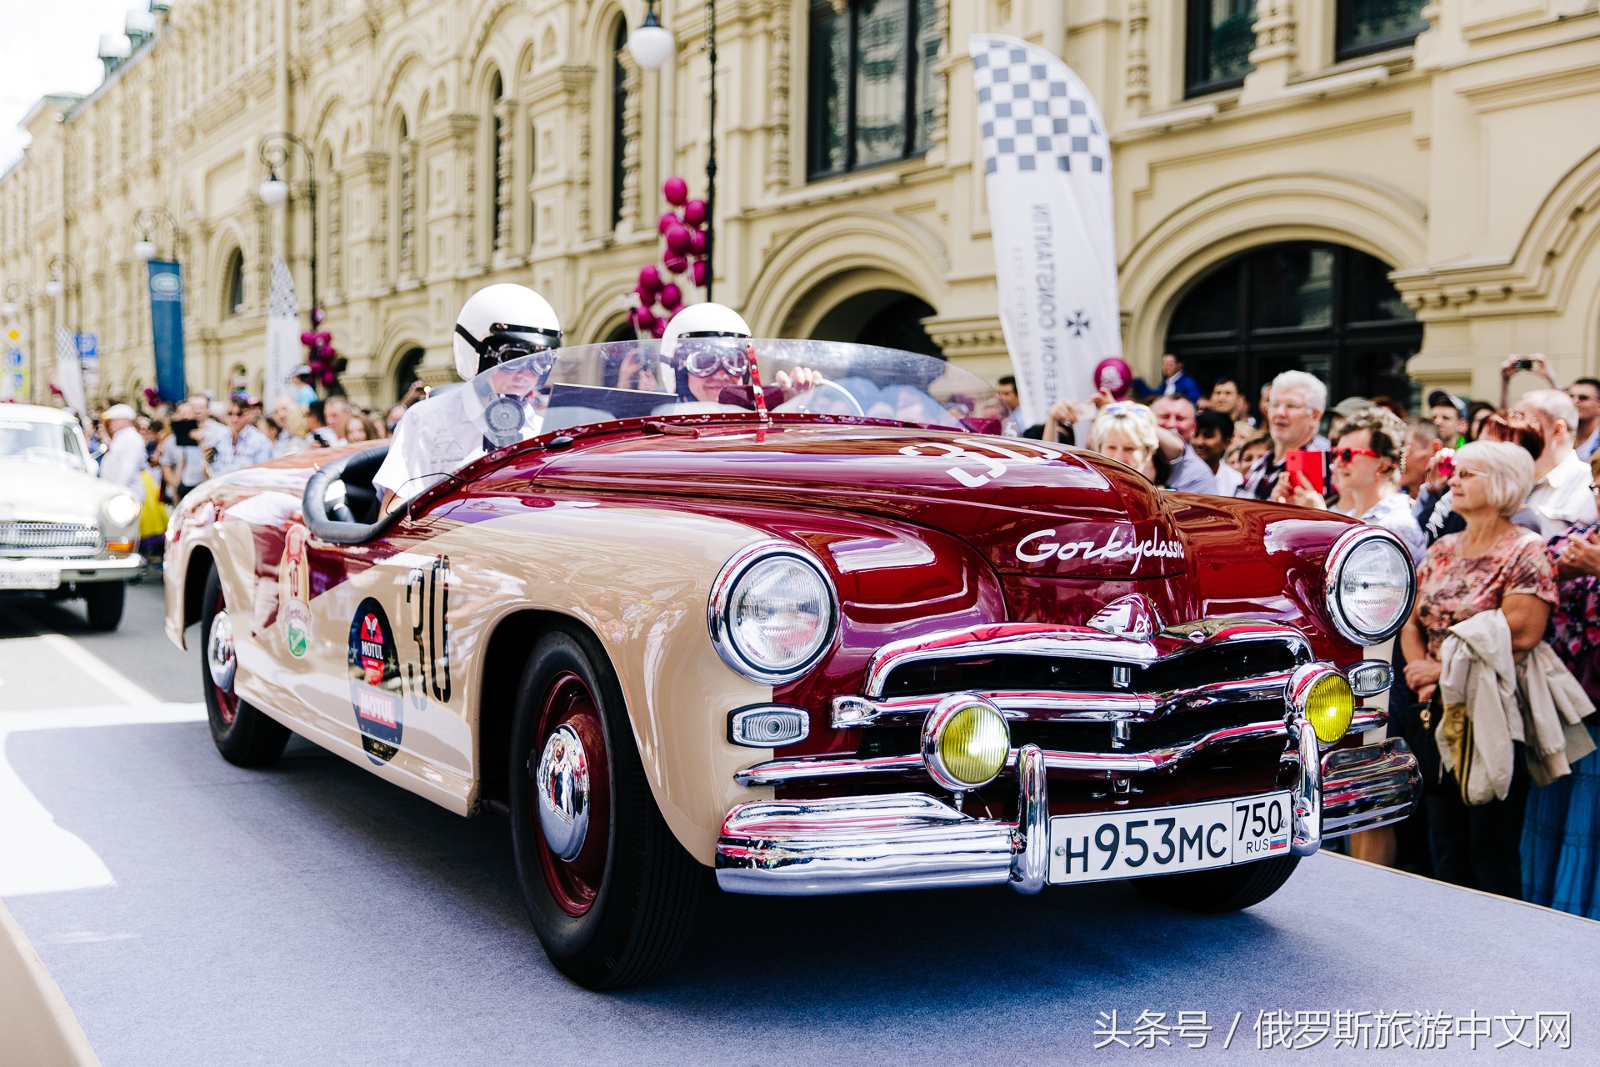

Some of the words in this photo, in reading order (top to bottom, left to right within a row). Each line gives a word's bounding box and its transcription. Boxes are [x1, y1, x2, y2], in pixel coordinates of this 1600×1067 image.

[407, 554, 451, 712] 30
[361, 641, 384, 660] MOTUL
[360, 692, 395, 725] MOTUL
[1235, 799, 1283, 841] 750
[1246, 838, 1269, 855] RUS
